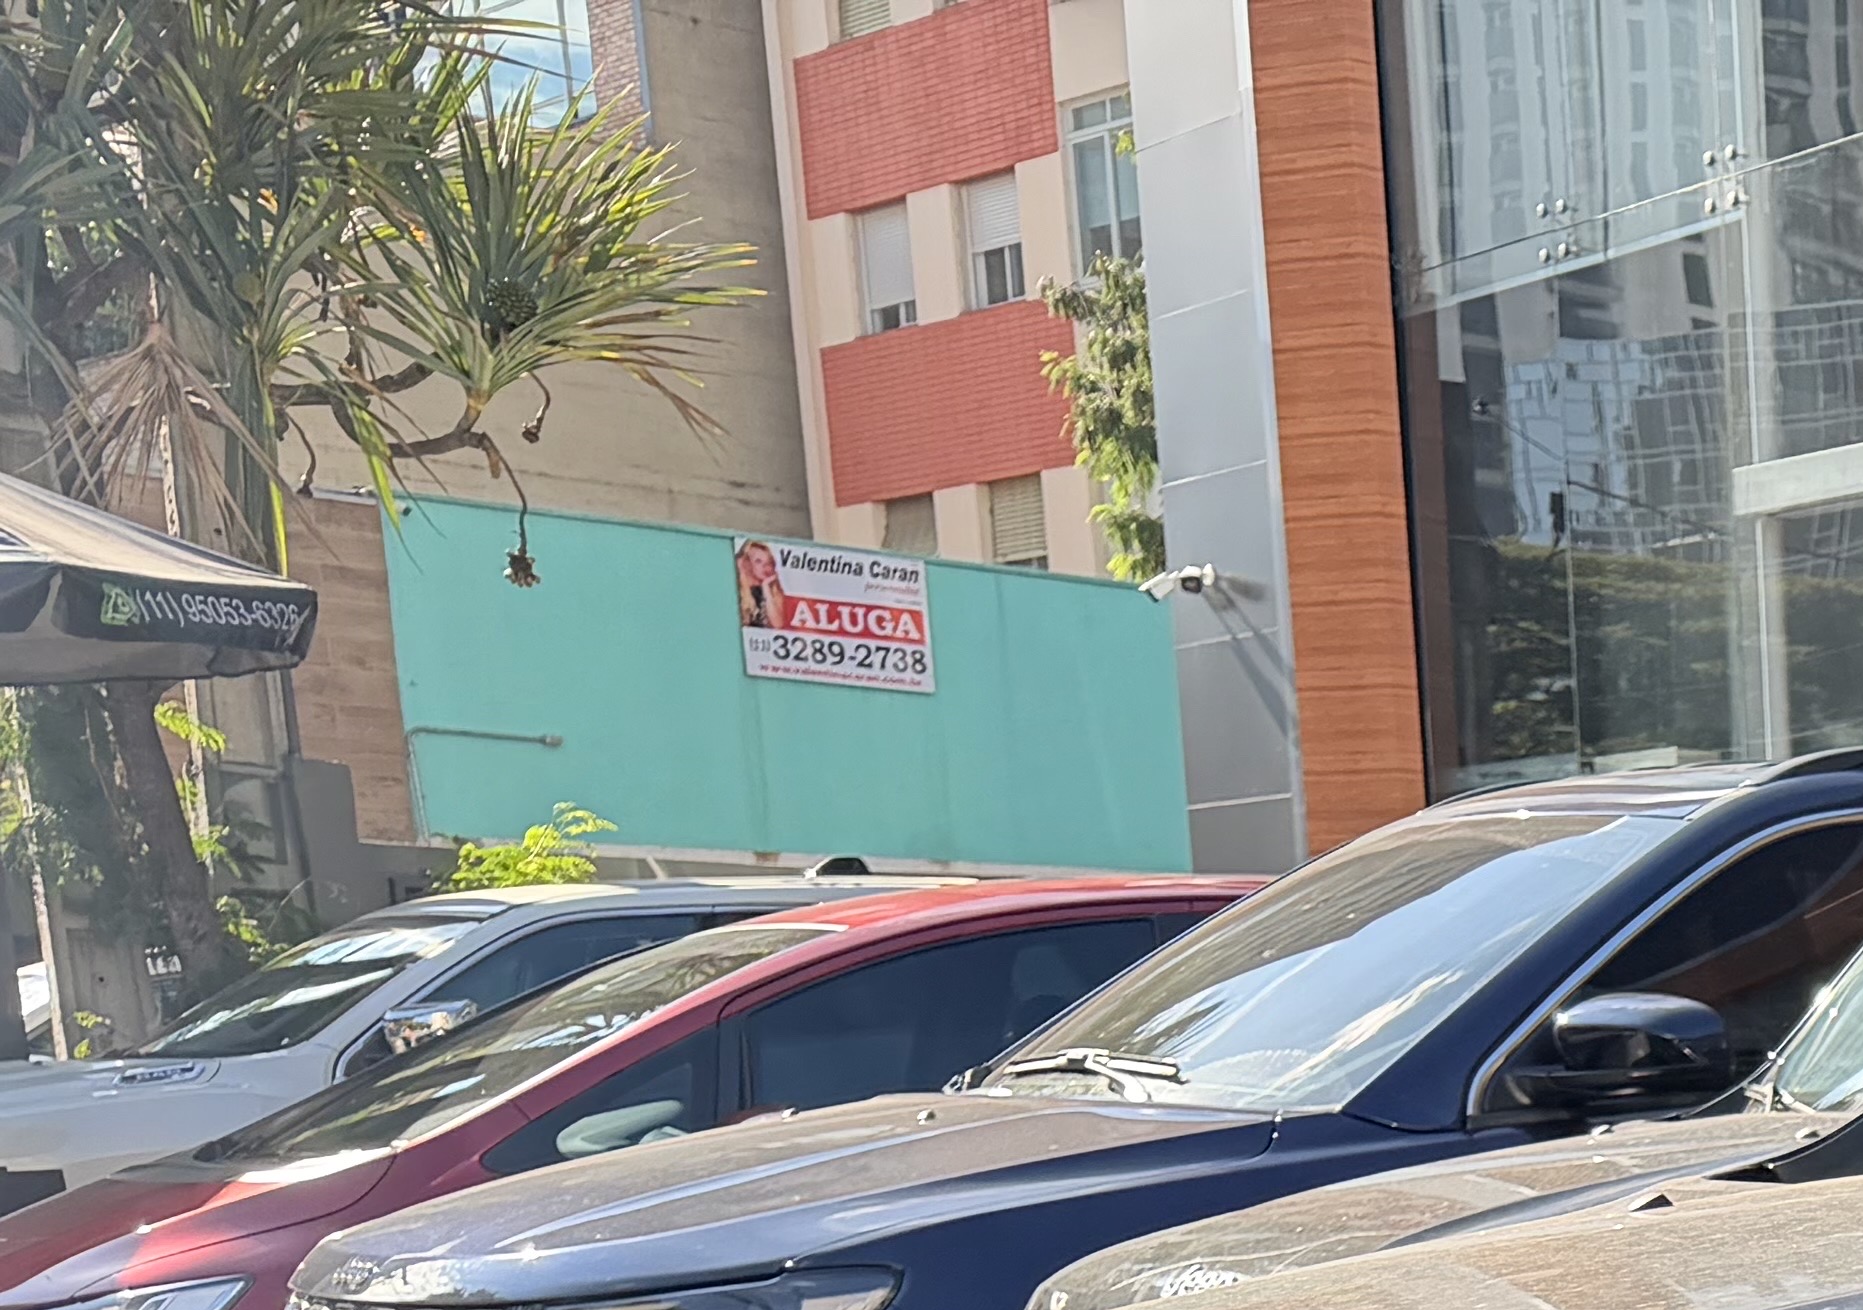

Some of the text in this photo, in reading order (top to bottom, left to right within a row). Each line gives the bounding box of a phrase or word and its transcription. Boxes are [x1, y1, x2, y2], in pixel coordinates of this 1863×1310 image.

[780, 549, 919, 583] Valentina Caran
[790, 600, 922, 640] ALUGA
[772, 634, 928, 674] 3289-2738
